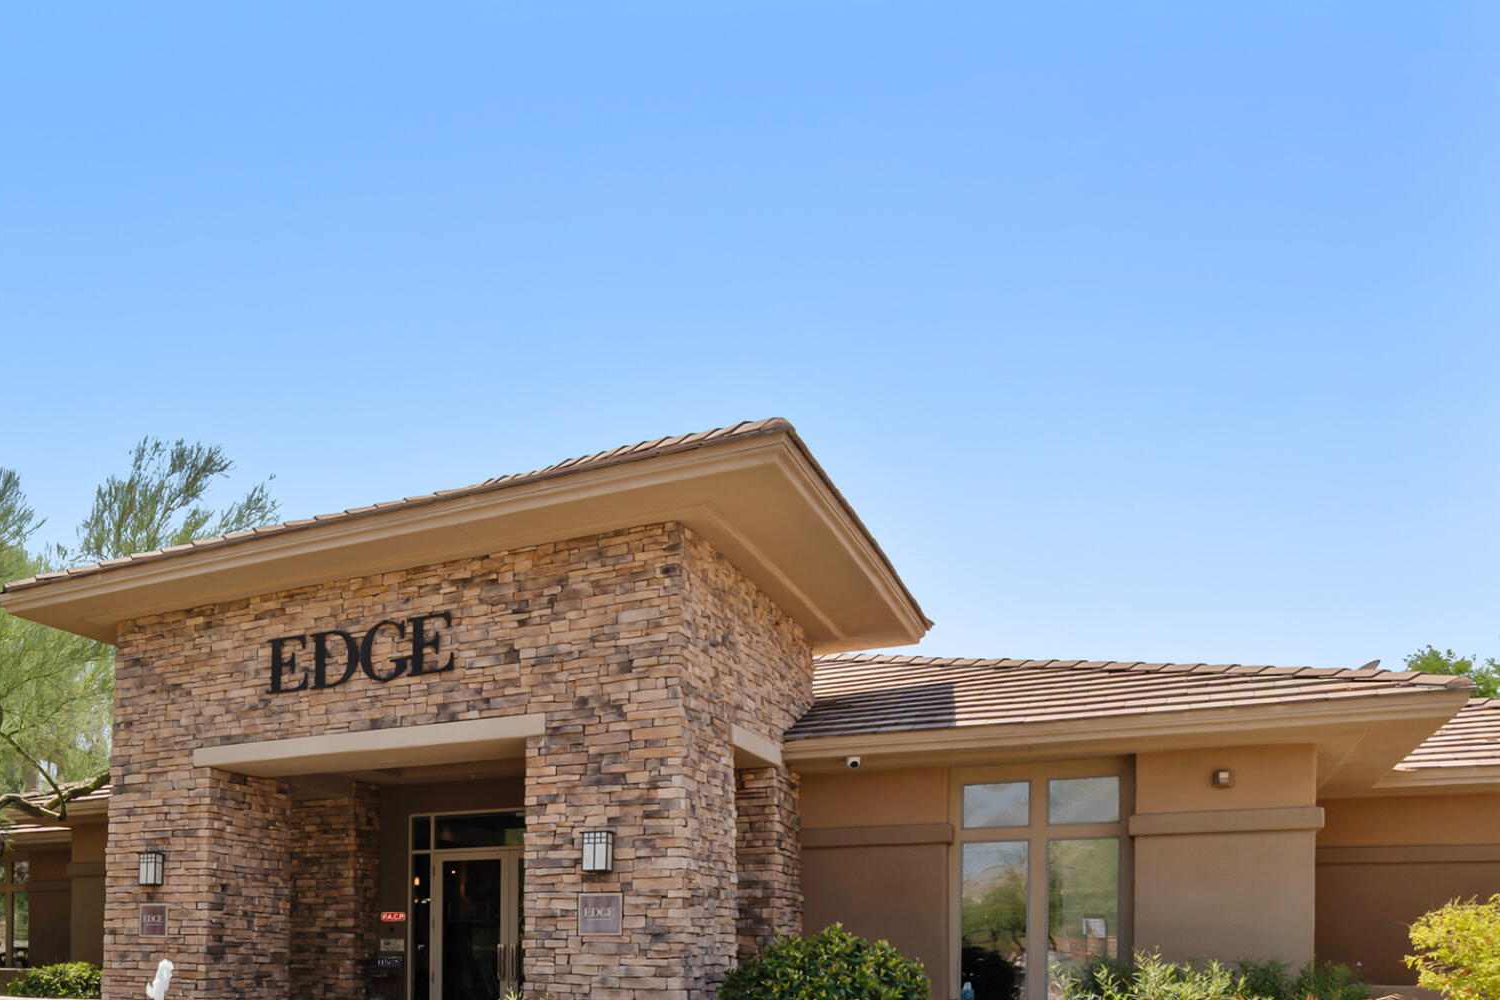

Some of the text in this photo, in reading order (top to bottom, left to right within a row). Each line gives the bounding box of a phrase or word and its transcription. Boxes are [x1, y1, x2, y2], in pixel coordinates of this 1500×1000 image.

[266, 611, 454, 694] EDGE
[584, 907, 615, 917] EDGE
[143, 914, 164, 923] EDGE
